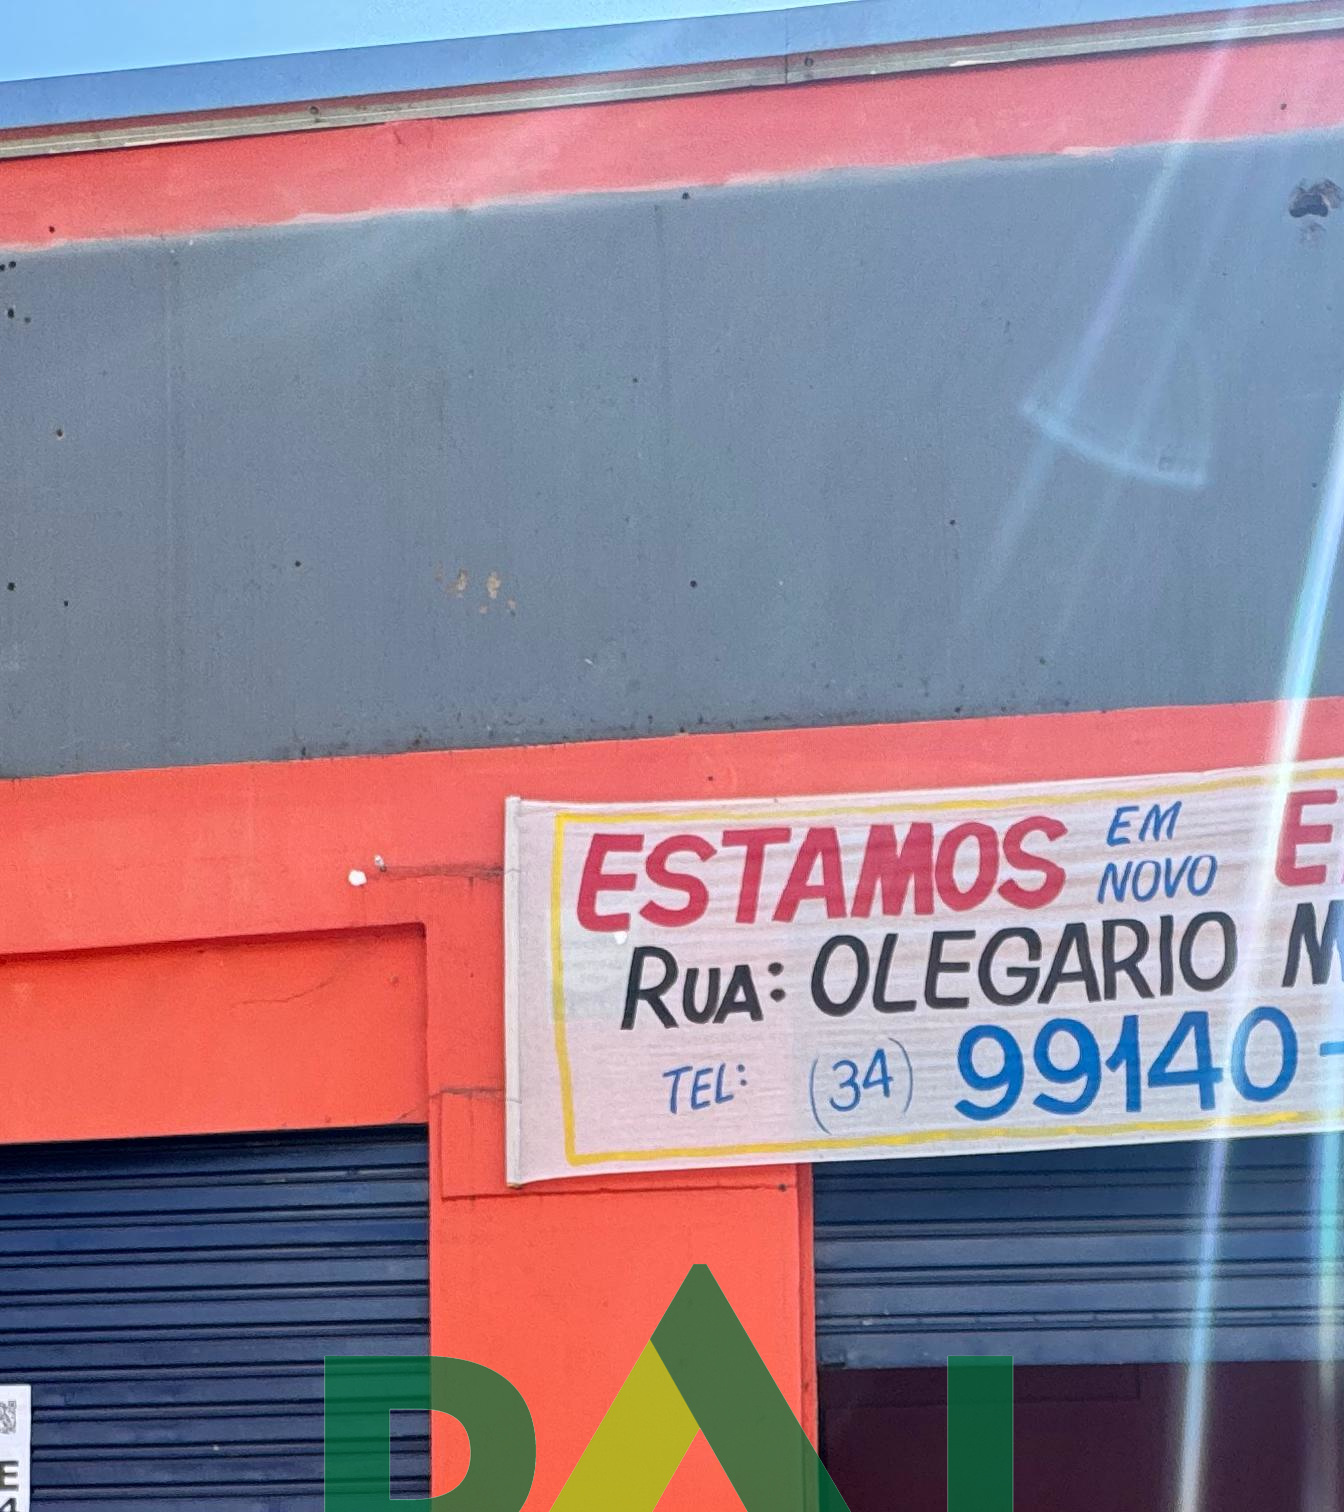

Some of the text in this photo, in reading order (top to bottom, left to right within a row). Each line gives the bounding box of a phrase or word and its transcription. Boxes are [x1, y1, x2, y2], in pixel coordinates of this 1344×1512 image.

[1105, 801, 1183, 847] EM
[575, 815, 1068, 933] ESTAMOS
[1097, 854, 1218, 905] NOVO
[809, 910, 1239, 1017] OLEGARIO
[661, 1061, 749, 1115] TEL:
[808, 1036, 914, 1135] (34)
